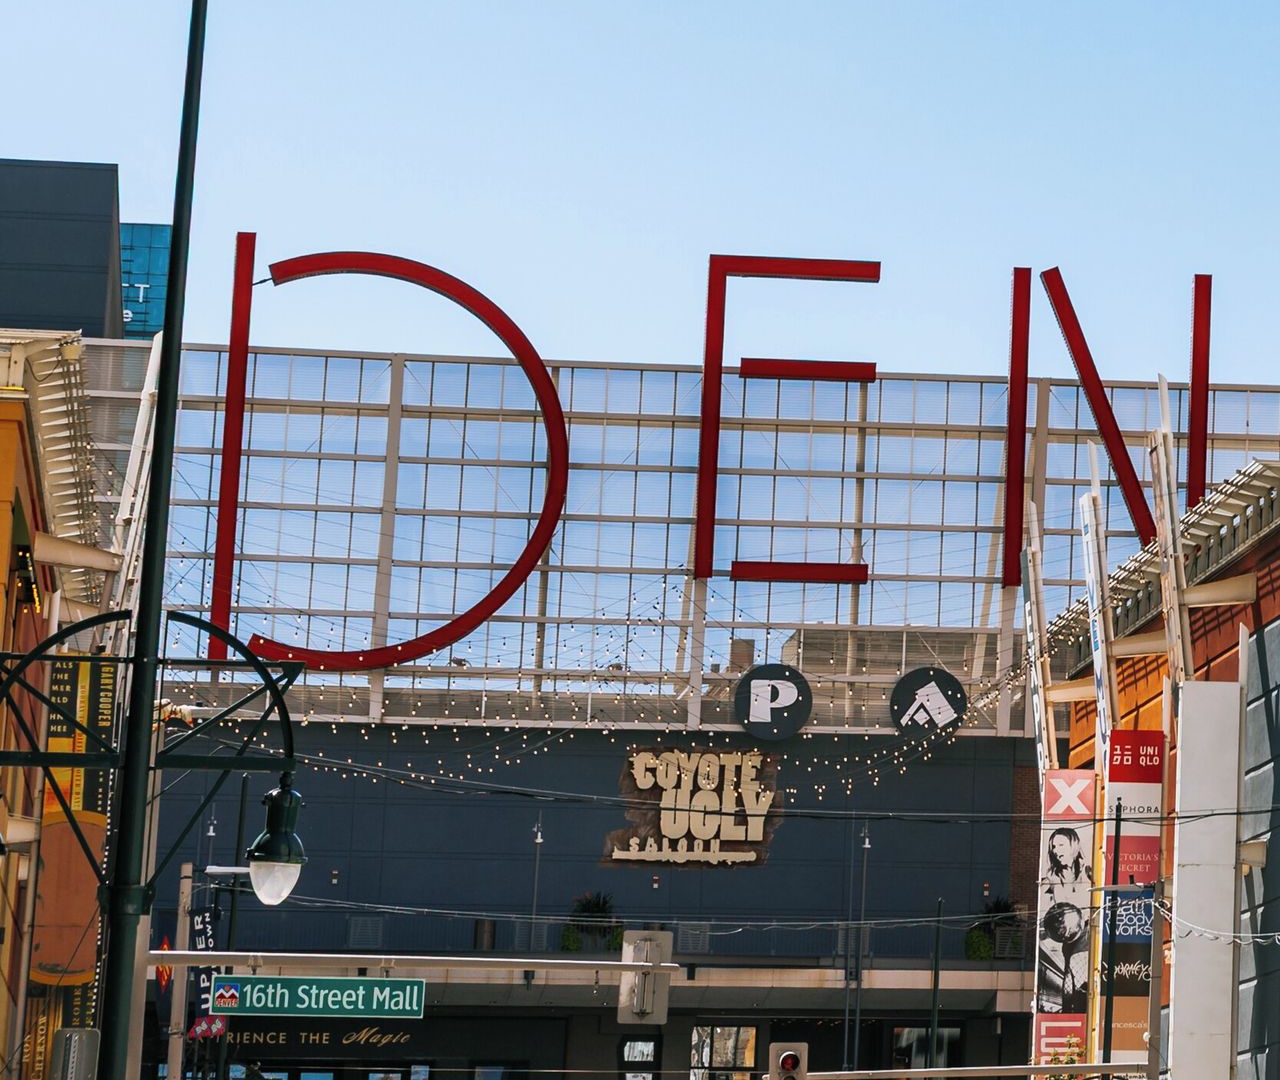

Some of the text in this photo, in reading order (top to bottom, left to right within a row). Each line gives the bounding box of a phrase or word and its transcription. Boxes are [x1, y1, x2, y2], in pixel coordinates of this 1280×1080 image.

[98, 666, 114, 727] GARY COOPER
[1139, 756, 1160, 767] QLO
[1140, 746, 1158, 755] UNI
[629, 749, 763, 790] COYOTE
[660, 788, 774, 841] UGLY
[1109, 805, 1160, 814] SPHORA
[629, 837, 721, 864] SALOON
[1107, 853, 1159, 862] VCTORIA'S
[194, 914, 211, 1010] UPER
[243, 983, 419, 1011] 16th Street Mall
[1102, 1019, 1149, 1028] fncesca's
[301, 1032, 330, 1044] THE
[342, 1027, 411, 1047] Magic
